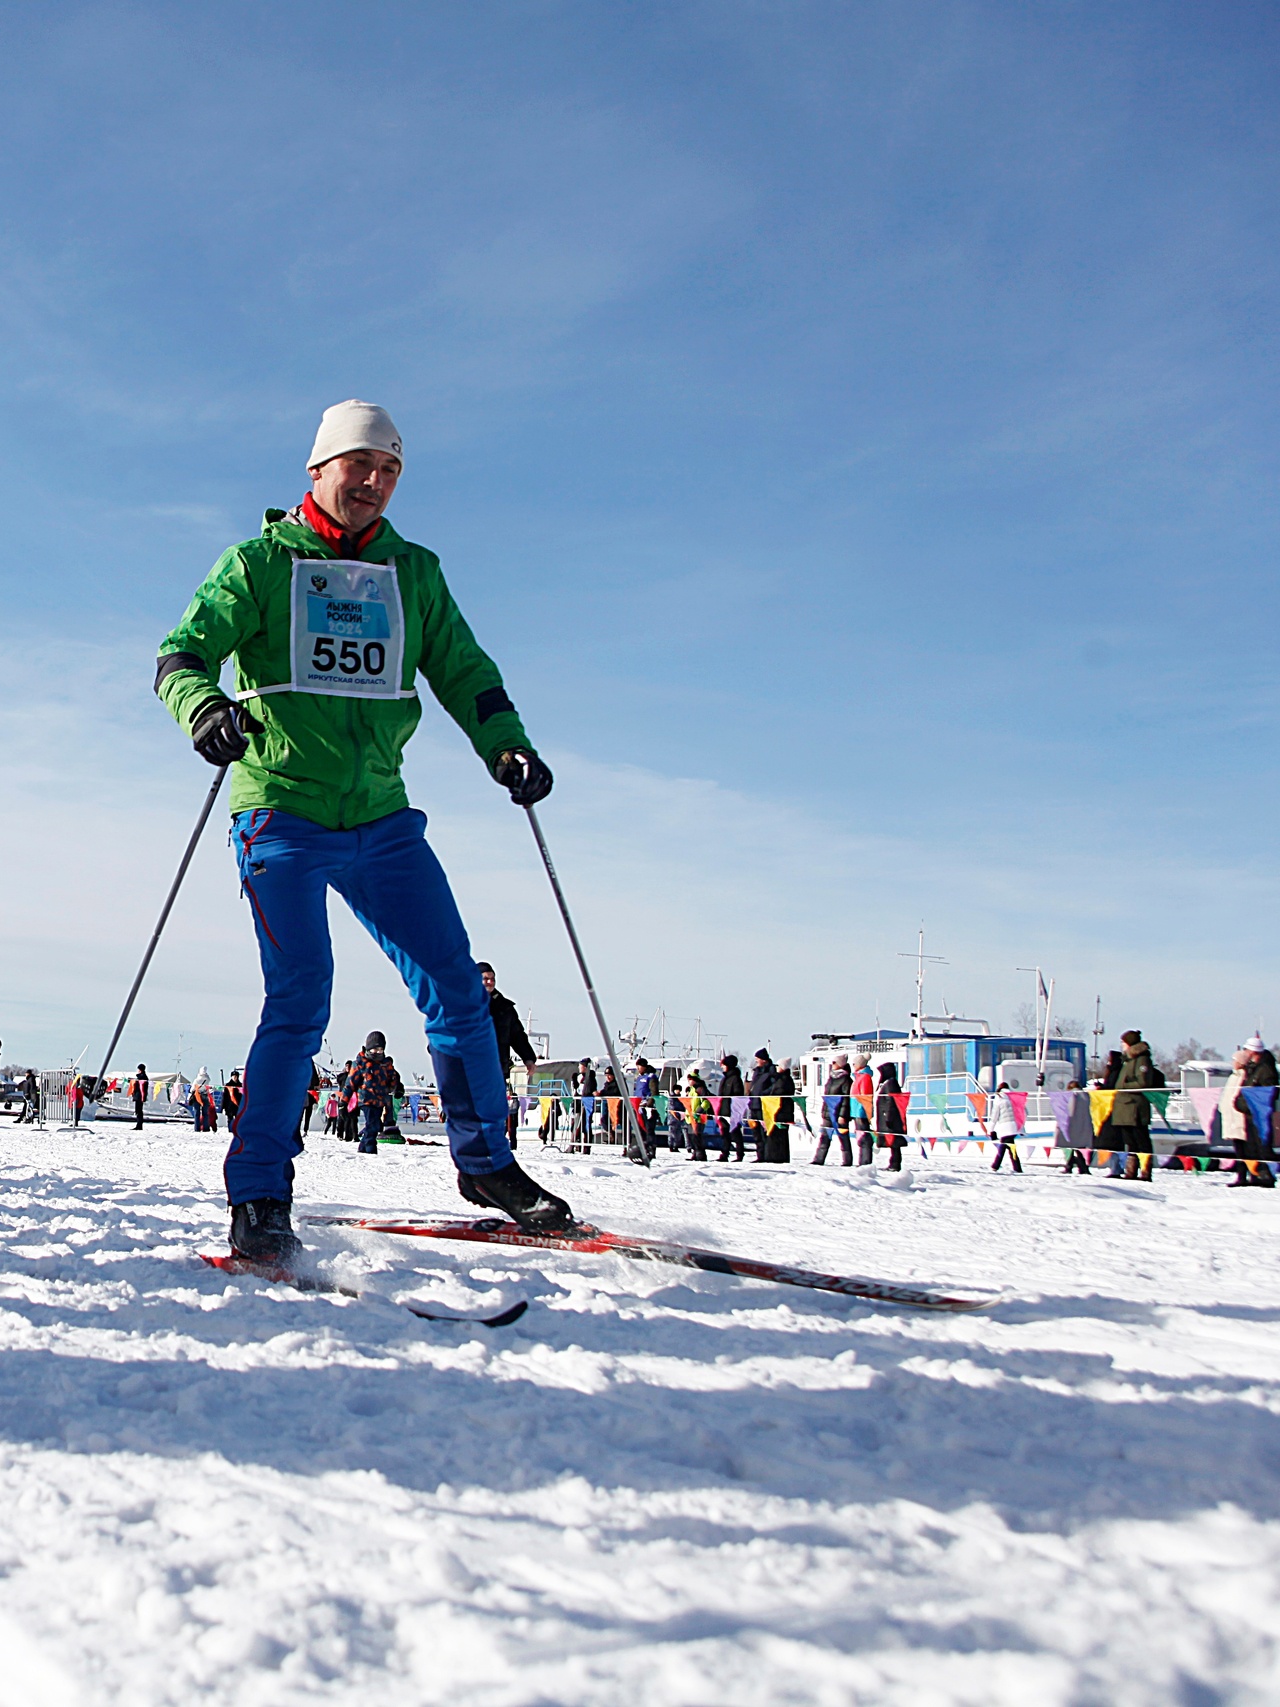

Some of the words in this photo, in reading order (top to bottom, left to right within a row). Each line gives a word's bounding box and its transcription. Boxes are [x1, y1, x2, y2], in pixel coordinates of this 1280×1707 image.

[326, 602, 362, 613] ЛЫЖНЯ
[327, 611, 362, 623] РОССИИ
[329, 621, 363, 635] 2024
[312, 637, 385, 675] 550
[307, 674, 353, 683] ИРКУТСКАЯ
[487, 1232, 574, 1250] PELTONEN
[774, 1269, 942, 1304] PELTONEN
